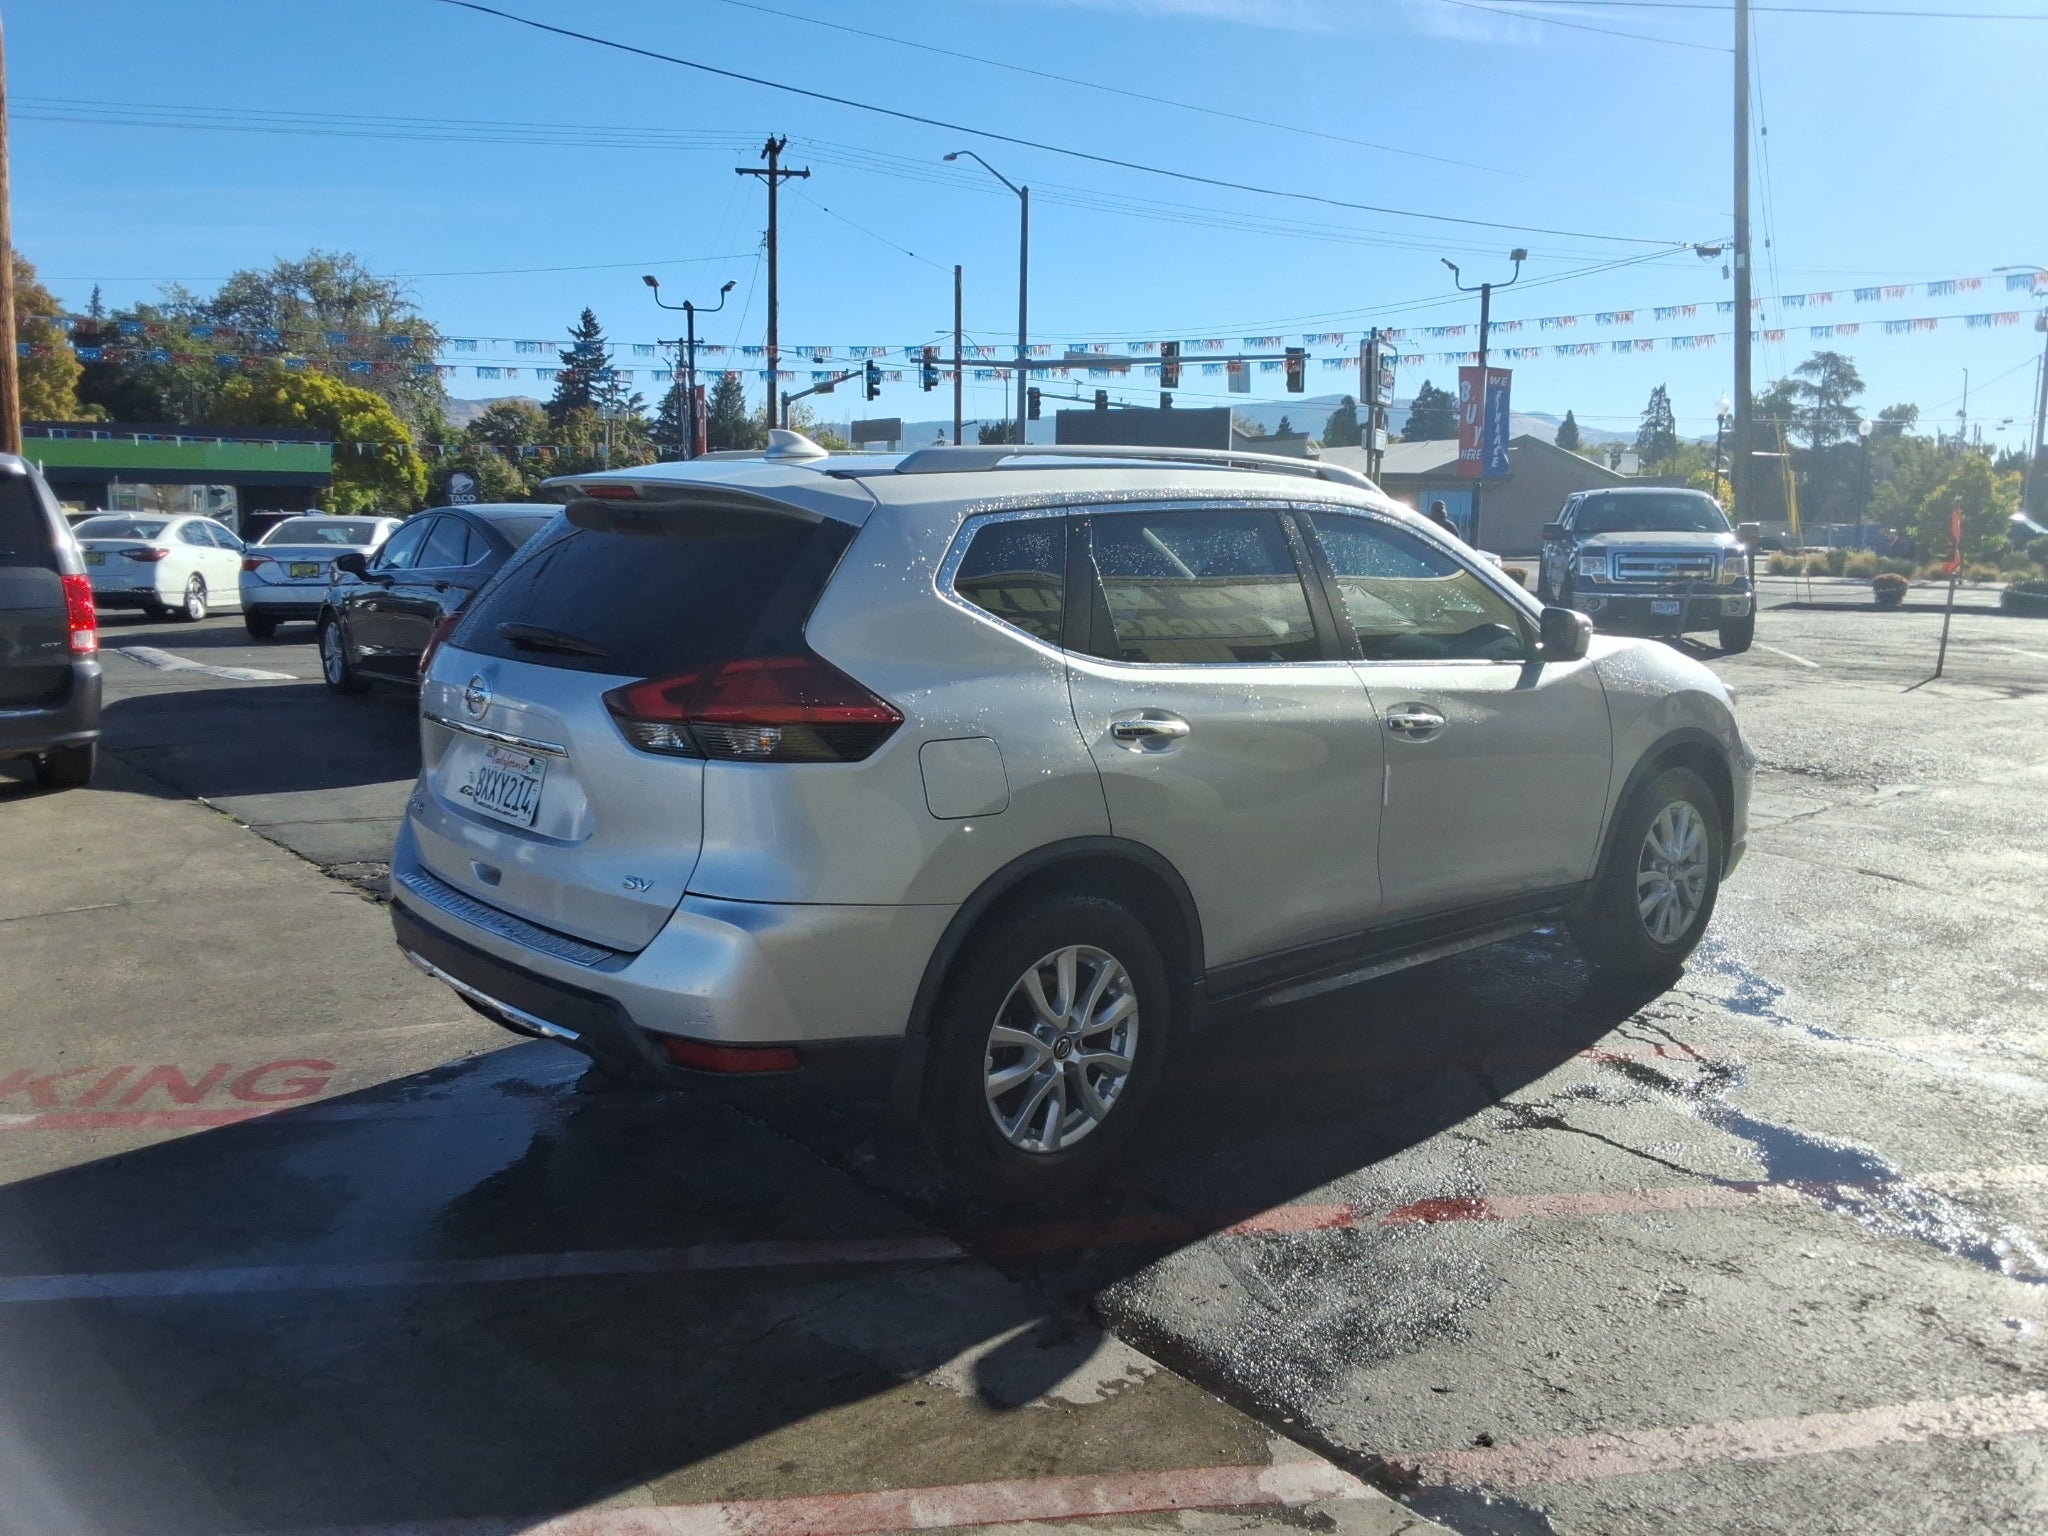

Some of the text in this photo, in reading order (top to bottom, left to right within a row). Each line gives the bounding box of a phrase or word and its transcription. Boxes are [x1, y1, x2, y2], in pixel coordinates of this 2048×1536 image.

[1489, 375, 1508, 387] WE
[1460, 380, 1482, 447] BUY
[1460, 448, 1482, 461] HERE
[449, 494, 476, 502] TACO
[475, 767, 533, 815] 8XXY214
[622, 875, 655, 893] SV
[0, 1059, 337, 1107] KING
